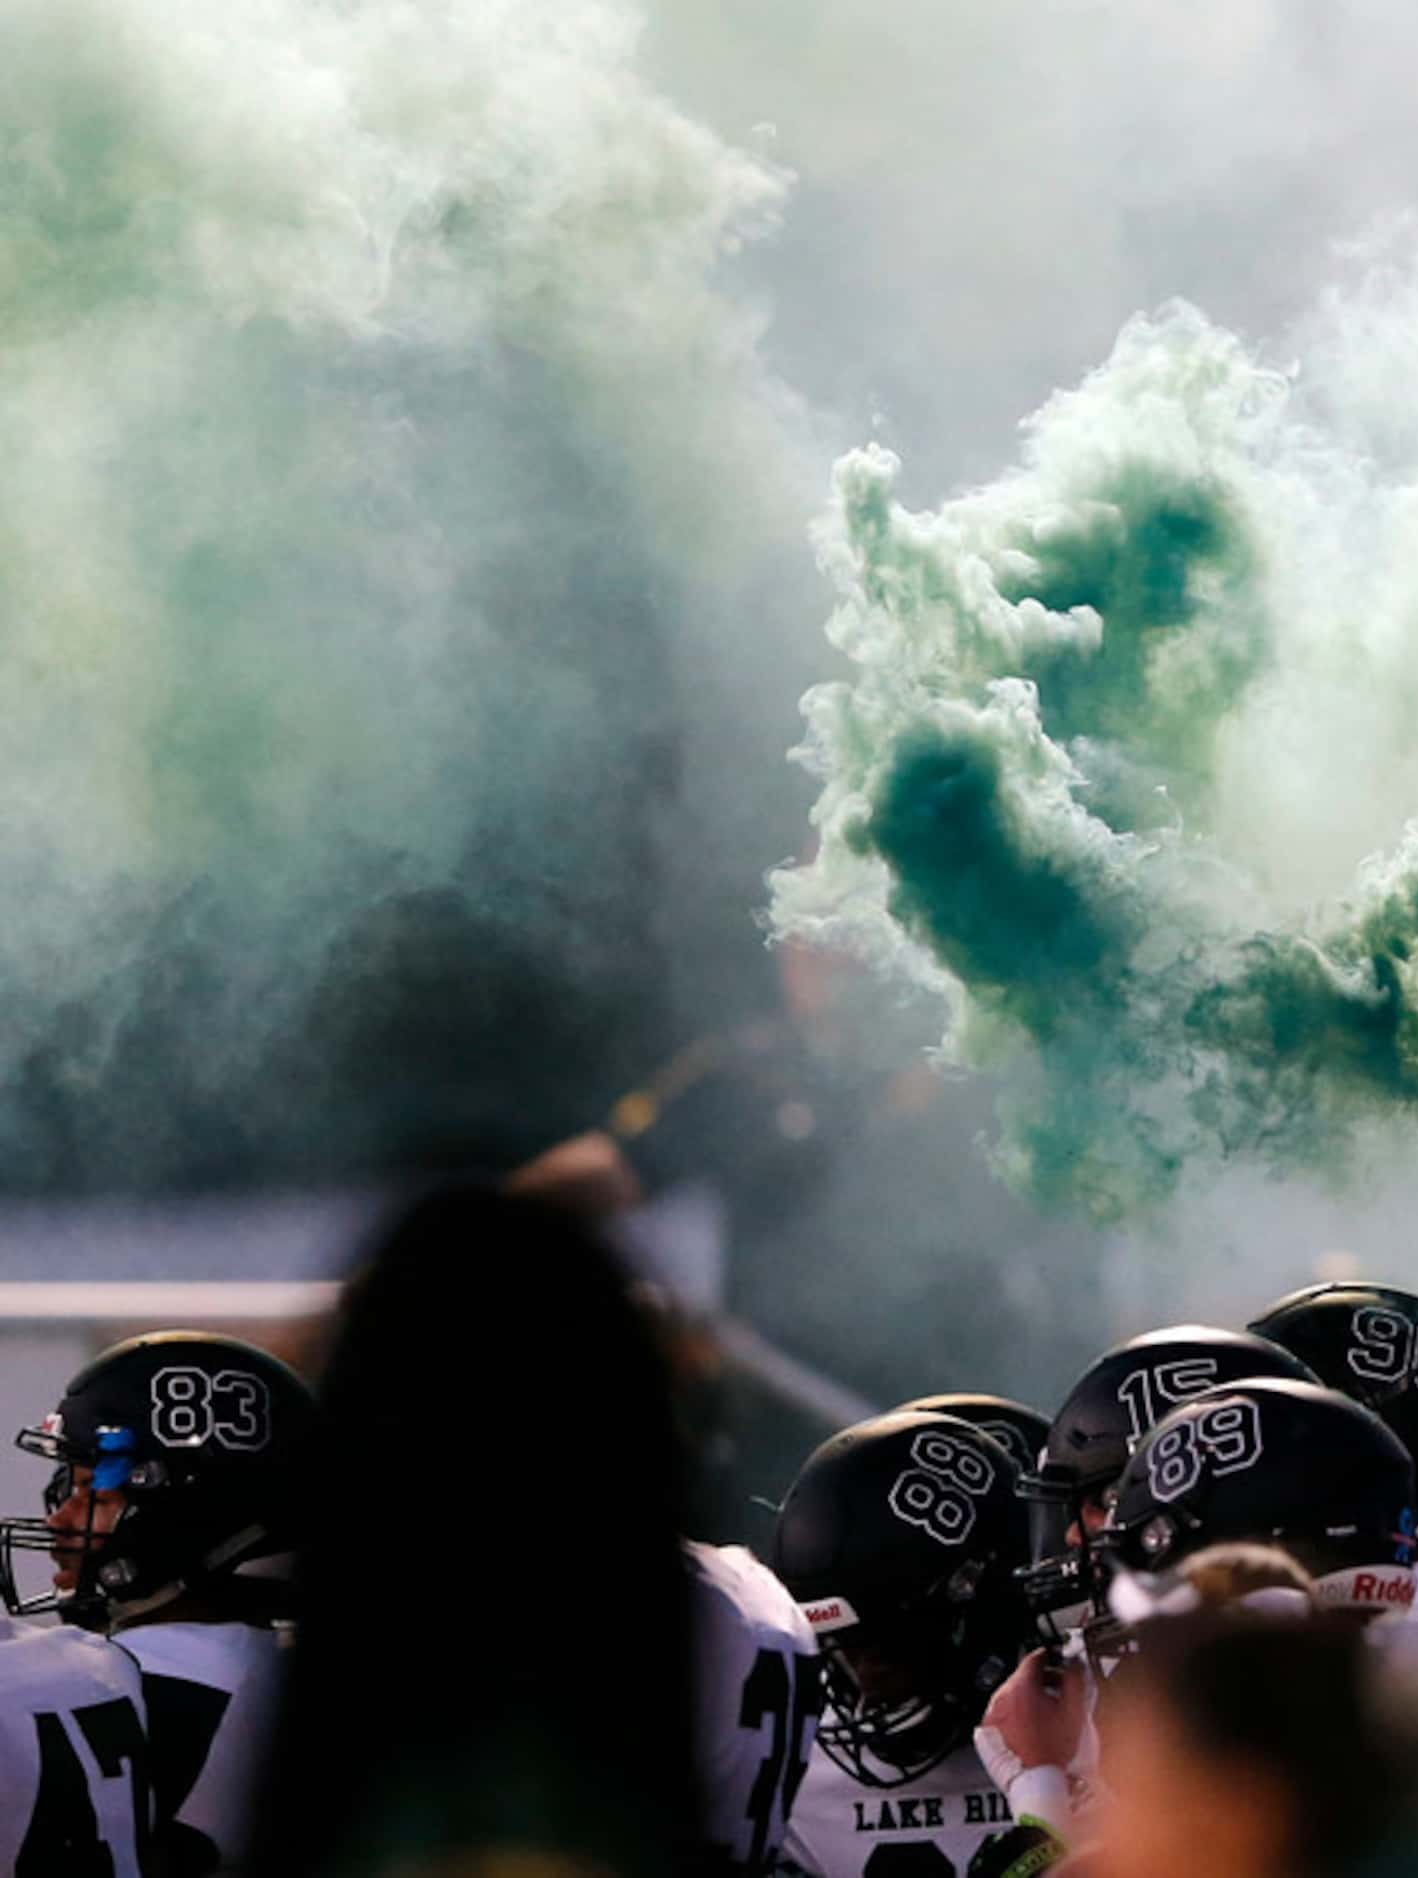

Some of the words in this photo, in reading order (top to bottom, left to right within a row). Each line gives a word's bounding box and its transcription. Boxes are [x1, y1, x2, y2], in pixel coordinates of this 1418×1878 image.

[151, 1366, 271, 1451] 83
[1147, 1400, 1263, 1502] 89
[888, 1430, 995, 1545] 88
[854, 1798, 944, 1832] LAKE
